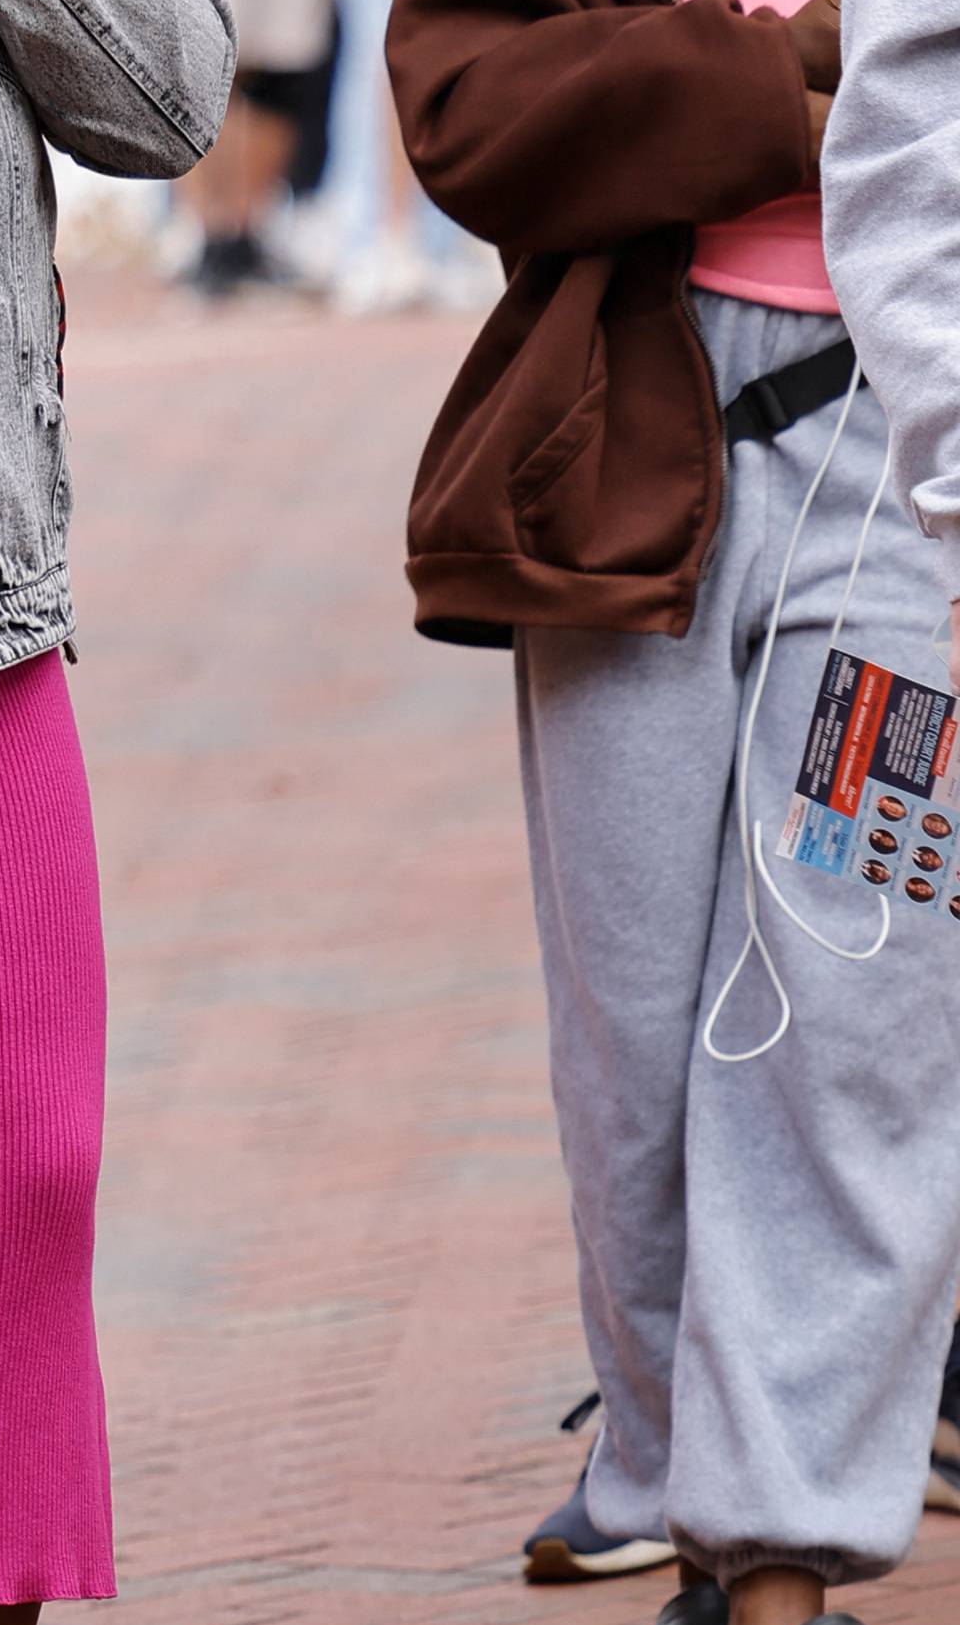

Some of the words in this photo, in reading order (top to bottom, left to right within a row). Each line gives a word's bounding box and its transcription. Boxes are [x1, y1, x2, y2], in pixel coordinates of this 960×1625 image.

[926, 694, 947, 734] DISTRICT
[919, 731, 938, 762] COURT
[913, 758, 931, 787] JUDGE
